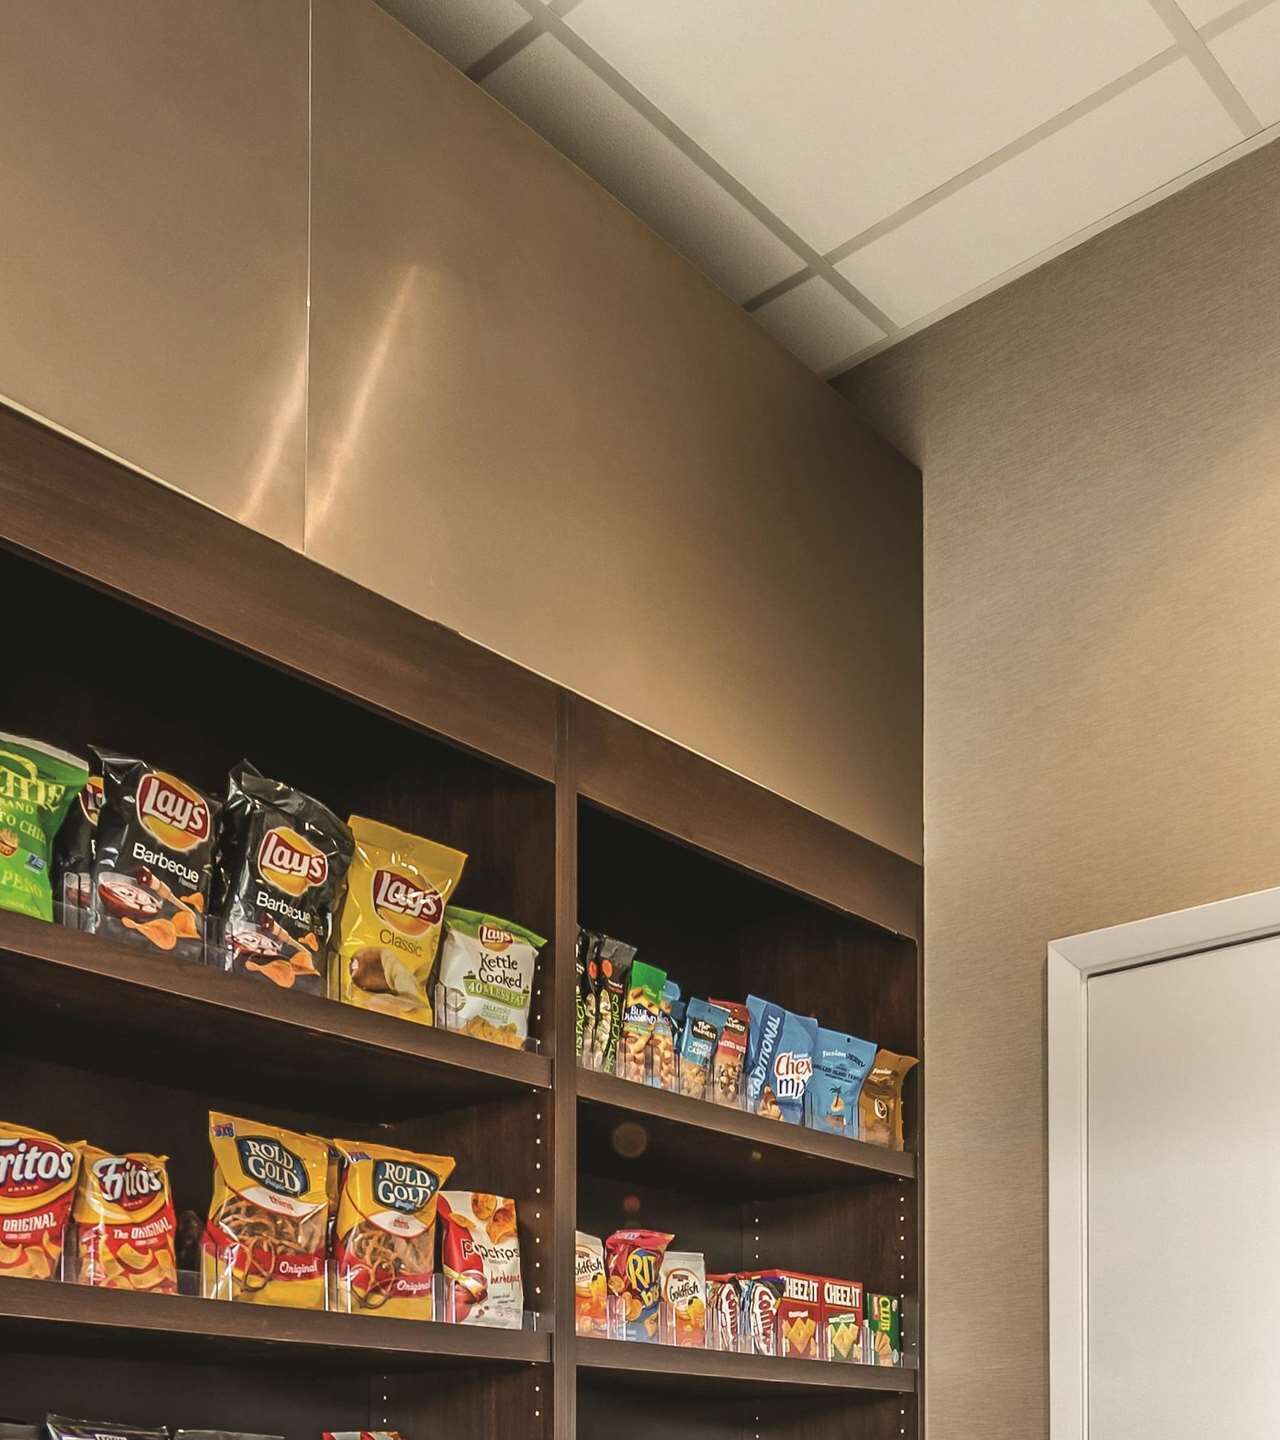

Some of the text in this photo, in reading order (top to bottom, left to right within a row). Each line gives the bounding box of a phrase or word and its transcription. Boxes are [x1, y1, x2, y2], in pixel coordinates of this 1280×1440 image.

[132, 842, 200, 884] Barbecue
[256, 890, 311, 925] Barbecue
[379, 929, 422, 957] Classic
[480, 953, 518, 971] Kettle
[478, 968, 521, 988] Cooked
[775, 1053, 812, 1076] Chex
[246, 1139, 294, 1171] ROLD
[92, 1157, 162, 1202] Fritos
[248, 1156, 301, 1191] GOLD
[383, 1160, 434, 1188] ROLD
[376, 1180, 433, 1205] GOLD
[3, 1212, 57, 1232] ORIGINAL
[112, 1217, 172, 1240] The ORIGINAL
[279, 1260, 318, 1277] Original
[396, 1279, 432, 1294] Original
[669, 1278, 700, 1301] Goldfish
[879, 1298, 891, 1331] CLUB
